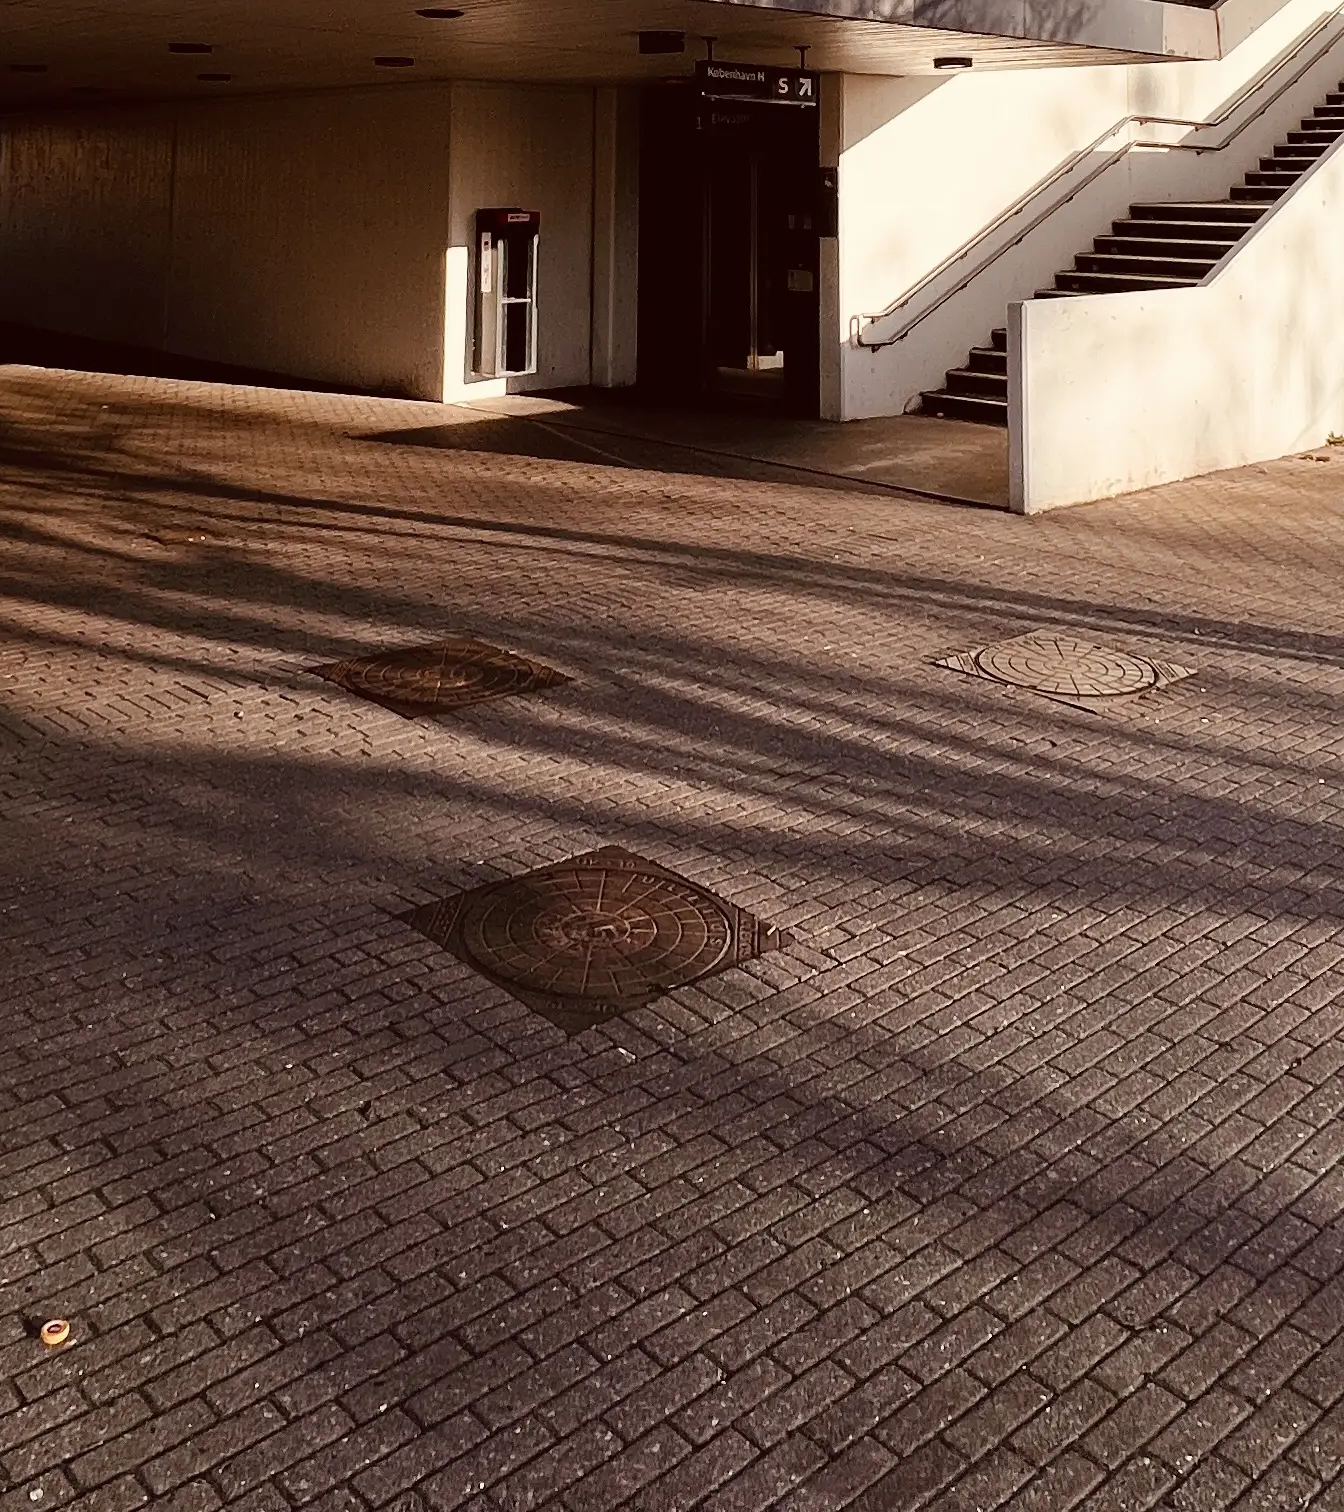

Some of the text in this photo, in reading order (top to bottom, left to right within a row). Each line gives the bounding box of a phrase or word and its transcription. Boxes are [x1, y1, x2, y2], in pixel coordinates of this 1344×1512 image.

[707, 67, 765, 83] København H
[778, 78, 789, 93] S
